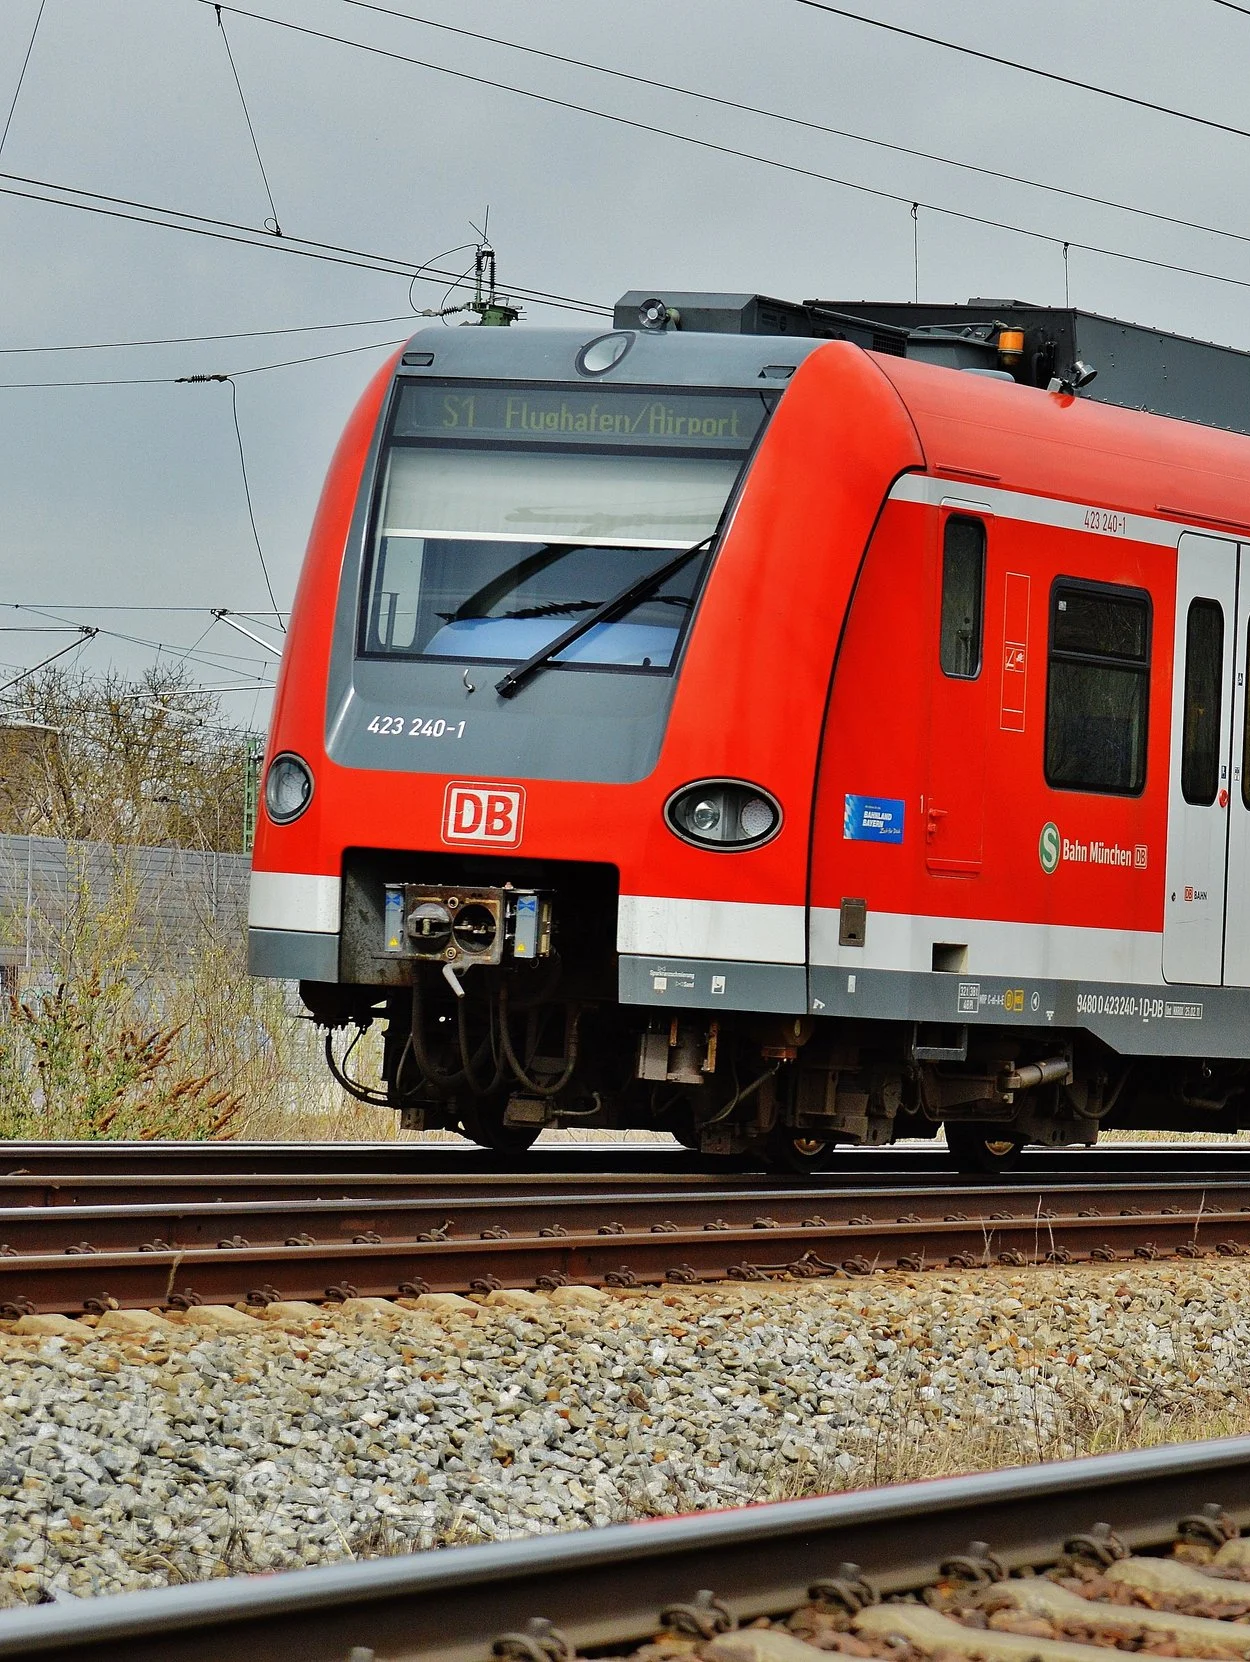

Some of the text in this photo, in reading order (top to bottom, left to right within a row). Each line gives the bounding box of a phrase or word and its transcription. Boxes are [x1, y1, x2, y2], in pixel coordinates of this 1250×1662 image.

[442, 394, 740, 438] S1 Flughafen/Airport
[1084, 510, 1126, 534] 423 240-1
[367, 715, 467, 739] 423 240-1
[452, 792, 515, 838] DB
[862, 818, 885, 828] BAYERN
[863, 810, 893, 821] BAHNLAND
[1042, 827, 1058, 869] S
[1062, 838, 1088, 863] Bahn
[1089, 841, 1132, 867] München
[1194, 890, 1208, 901] BAHN
